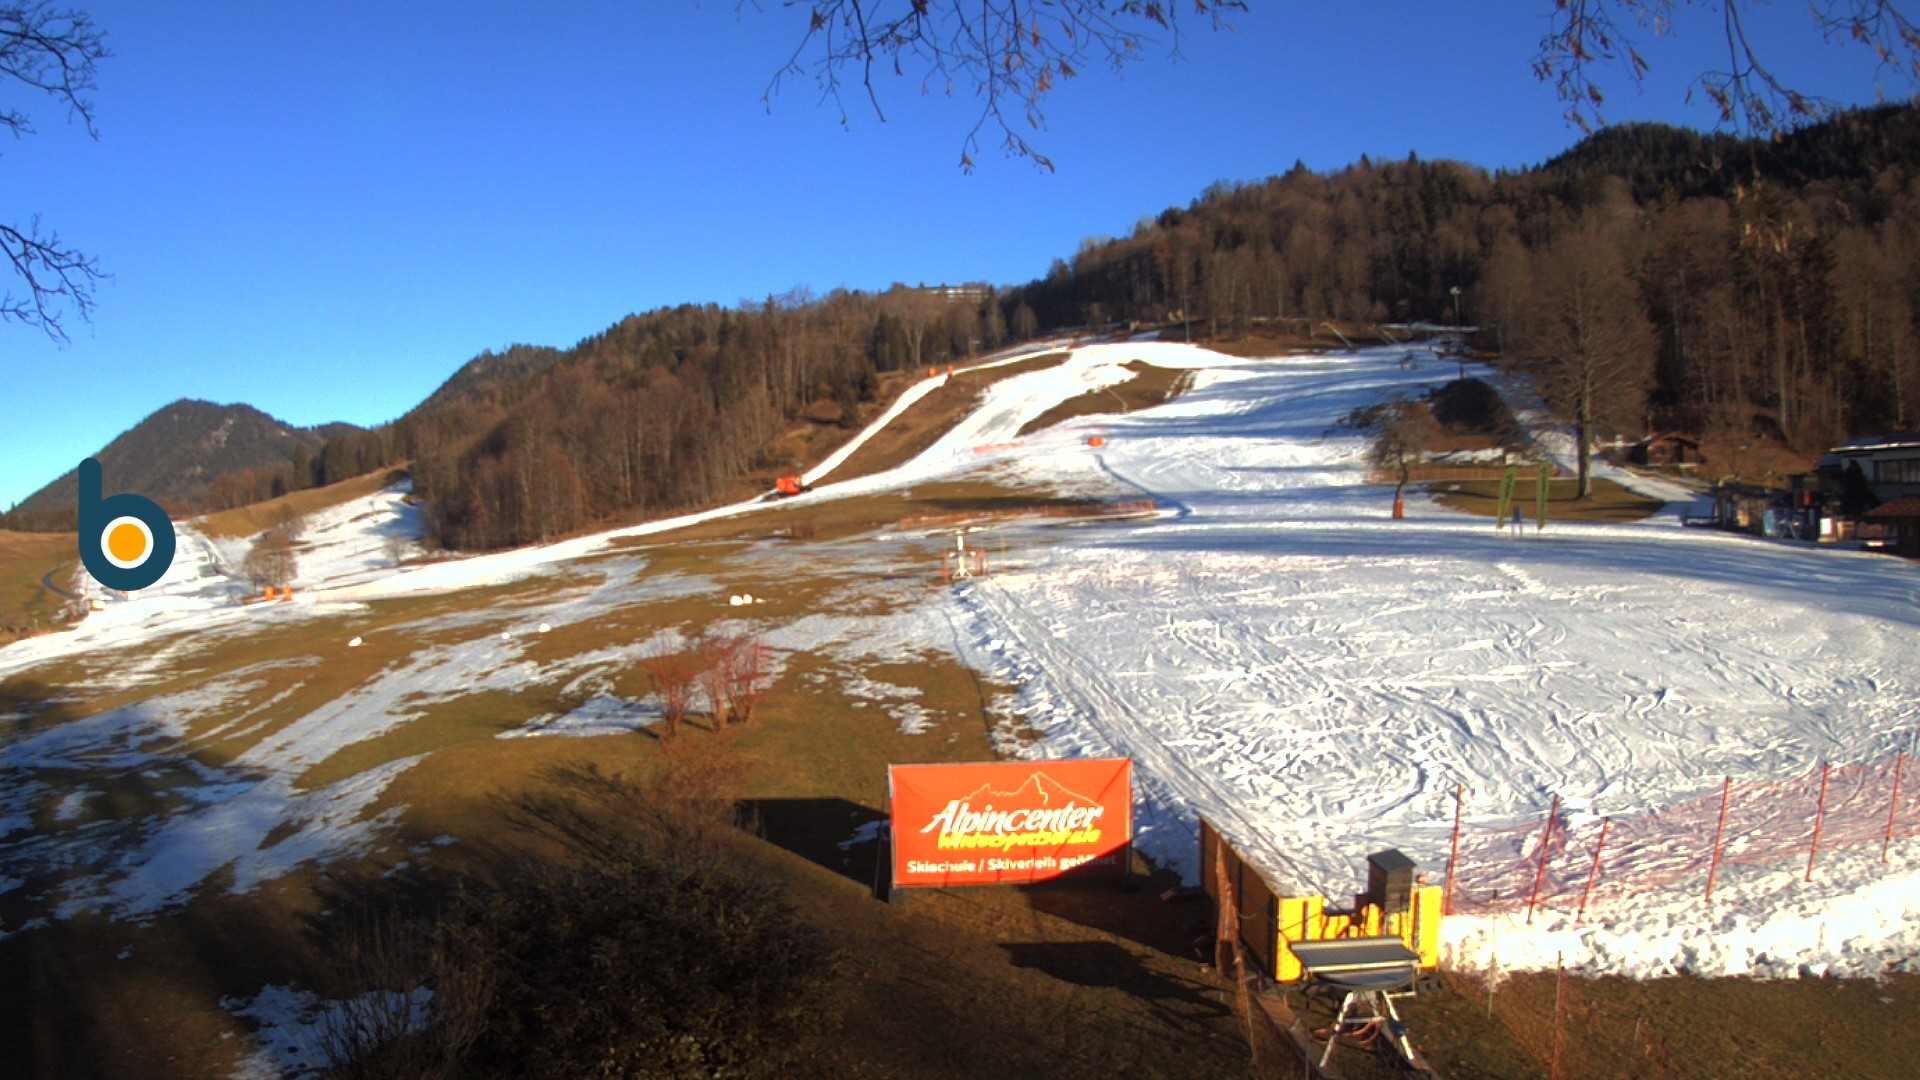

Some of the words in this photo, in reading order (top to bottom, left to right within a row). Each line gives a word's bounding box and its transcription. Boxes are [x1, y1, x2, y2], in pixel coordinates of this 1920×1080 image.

[919, 799, 1105, 836] Alpincenter
[906, 859, 976, 874] Skischule
[987, 857, 1056, 871] Skiverleih
